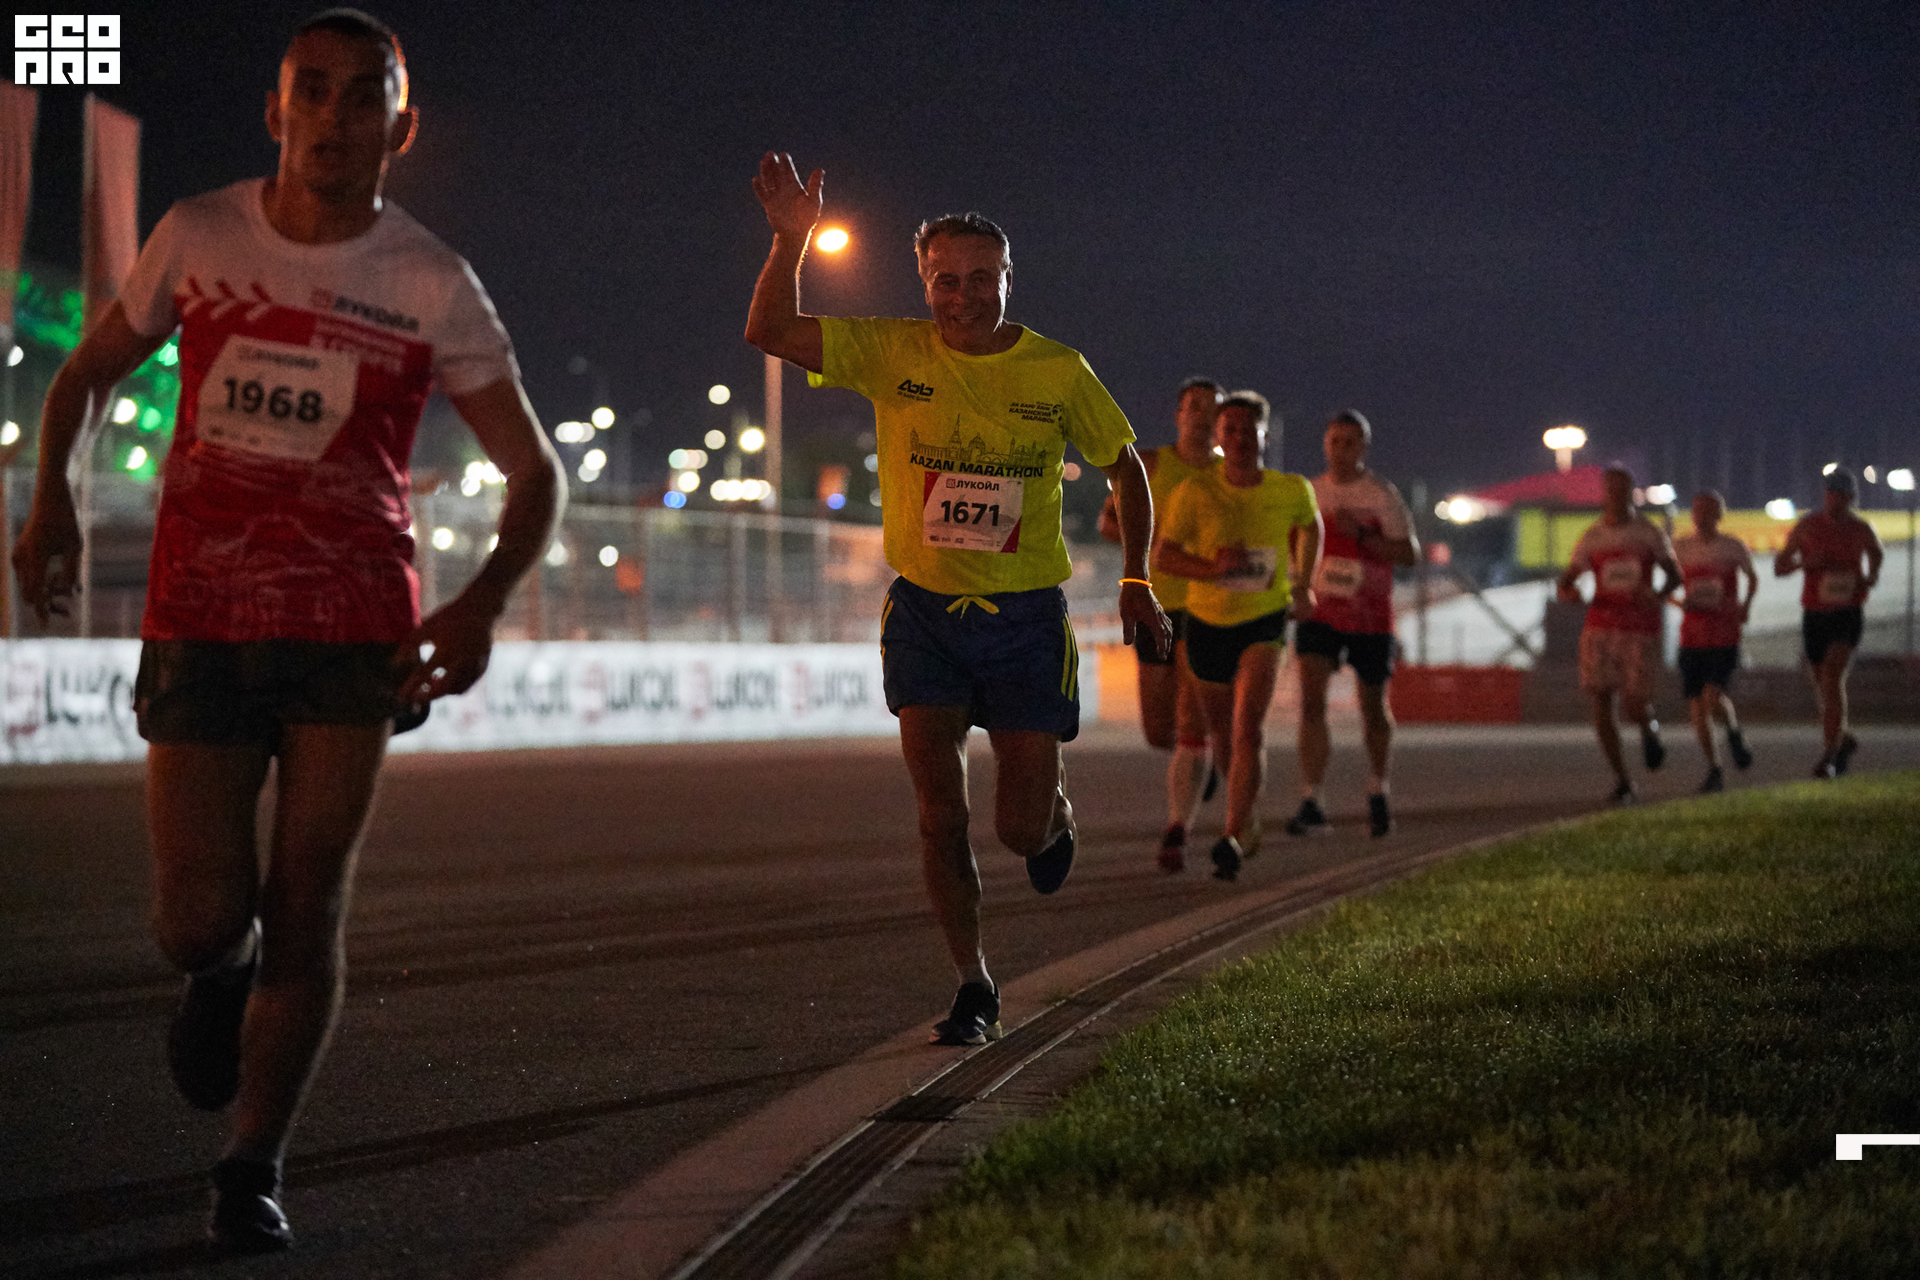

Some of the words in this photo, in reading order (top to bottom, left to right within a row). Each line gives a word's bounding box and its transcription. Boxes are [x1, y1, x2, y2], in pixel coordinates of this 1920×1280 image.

[223, 377, 322, 423] 1968
[910, 453, 955, 471] KAZAN
[958, 462, 1043, 478] MARATHON
[956, 480, 999, 491] ЛУКОЙЛ
[941, 500, 999, 526] 1671
